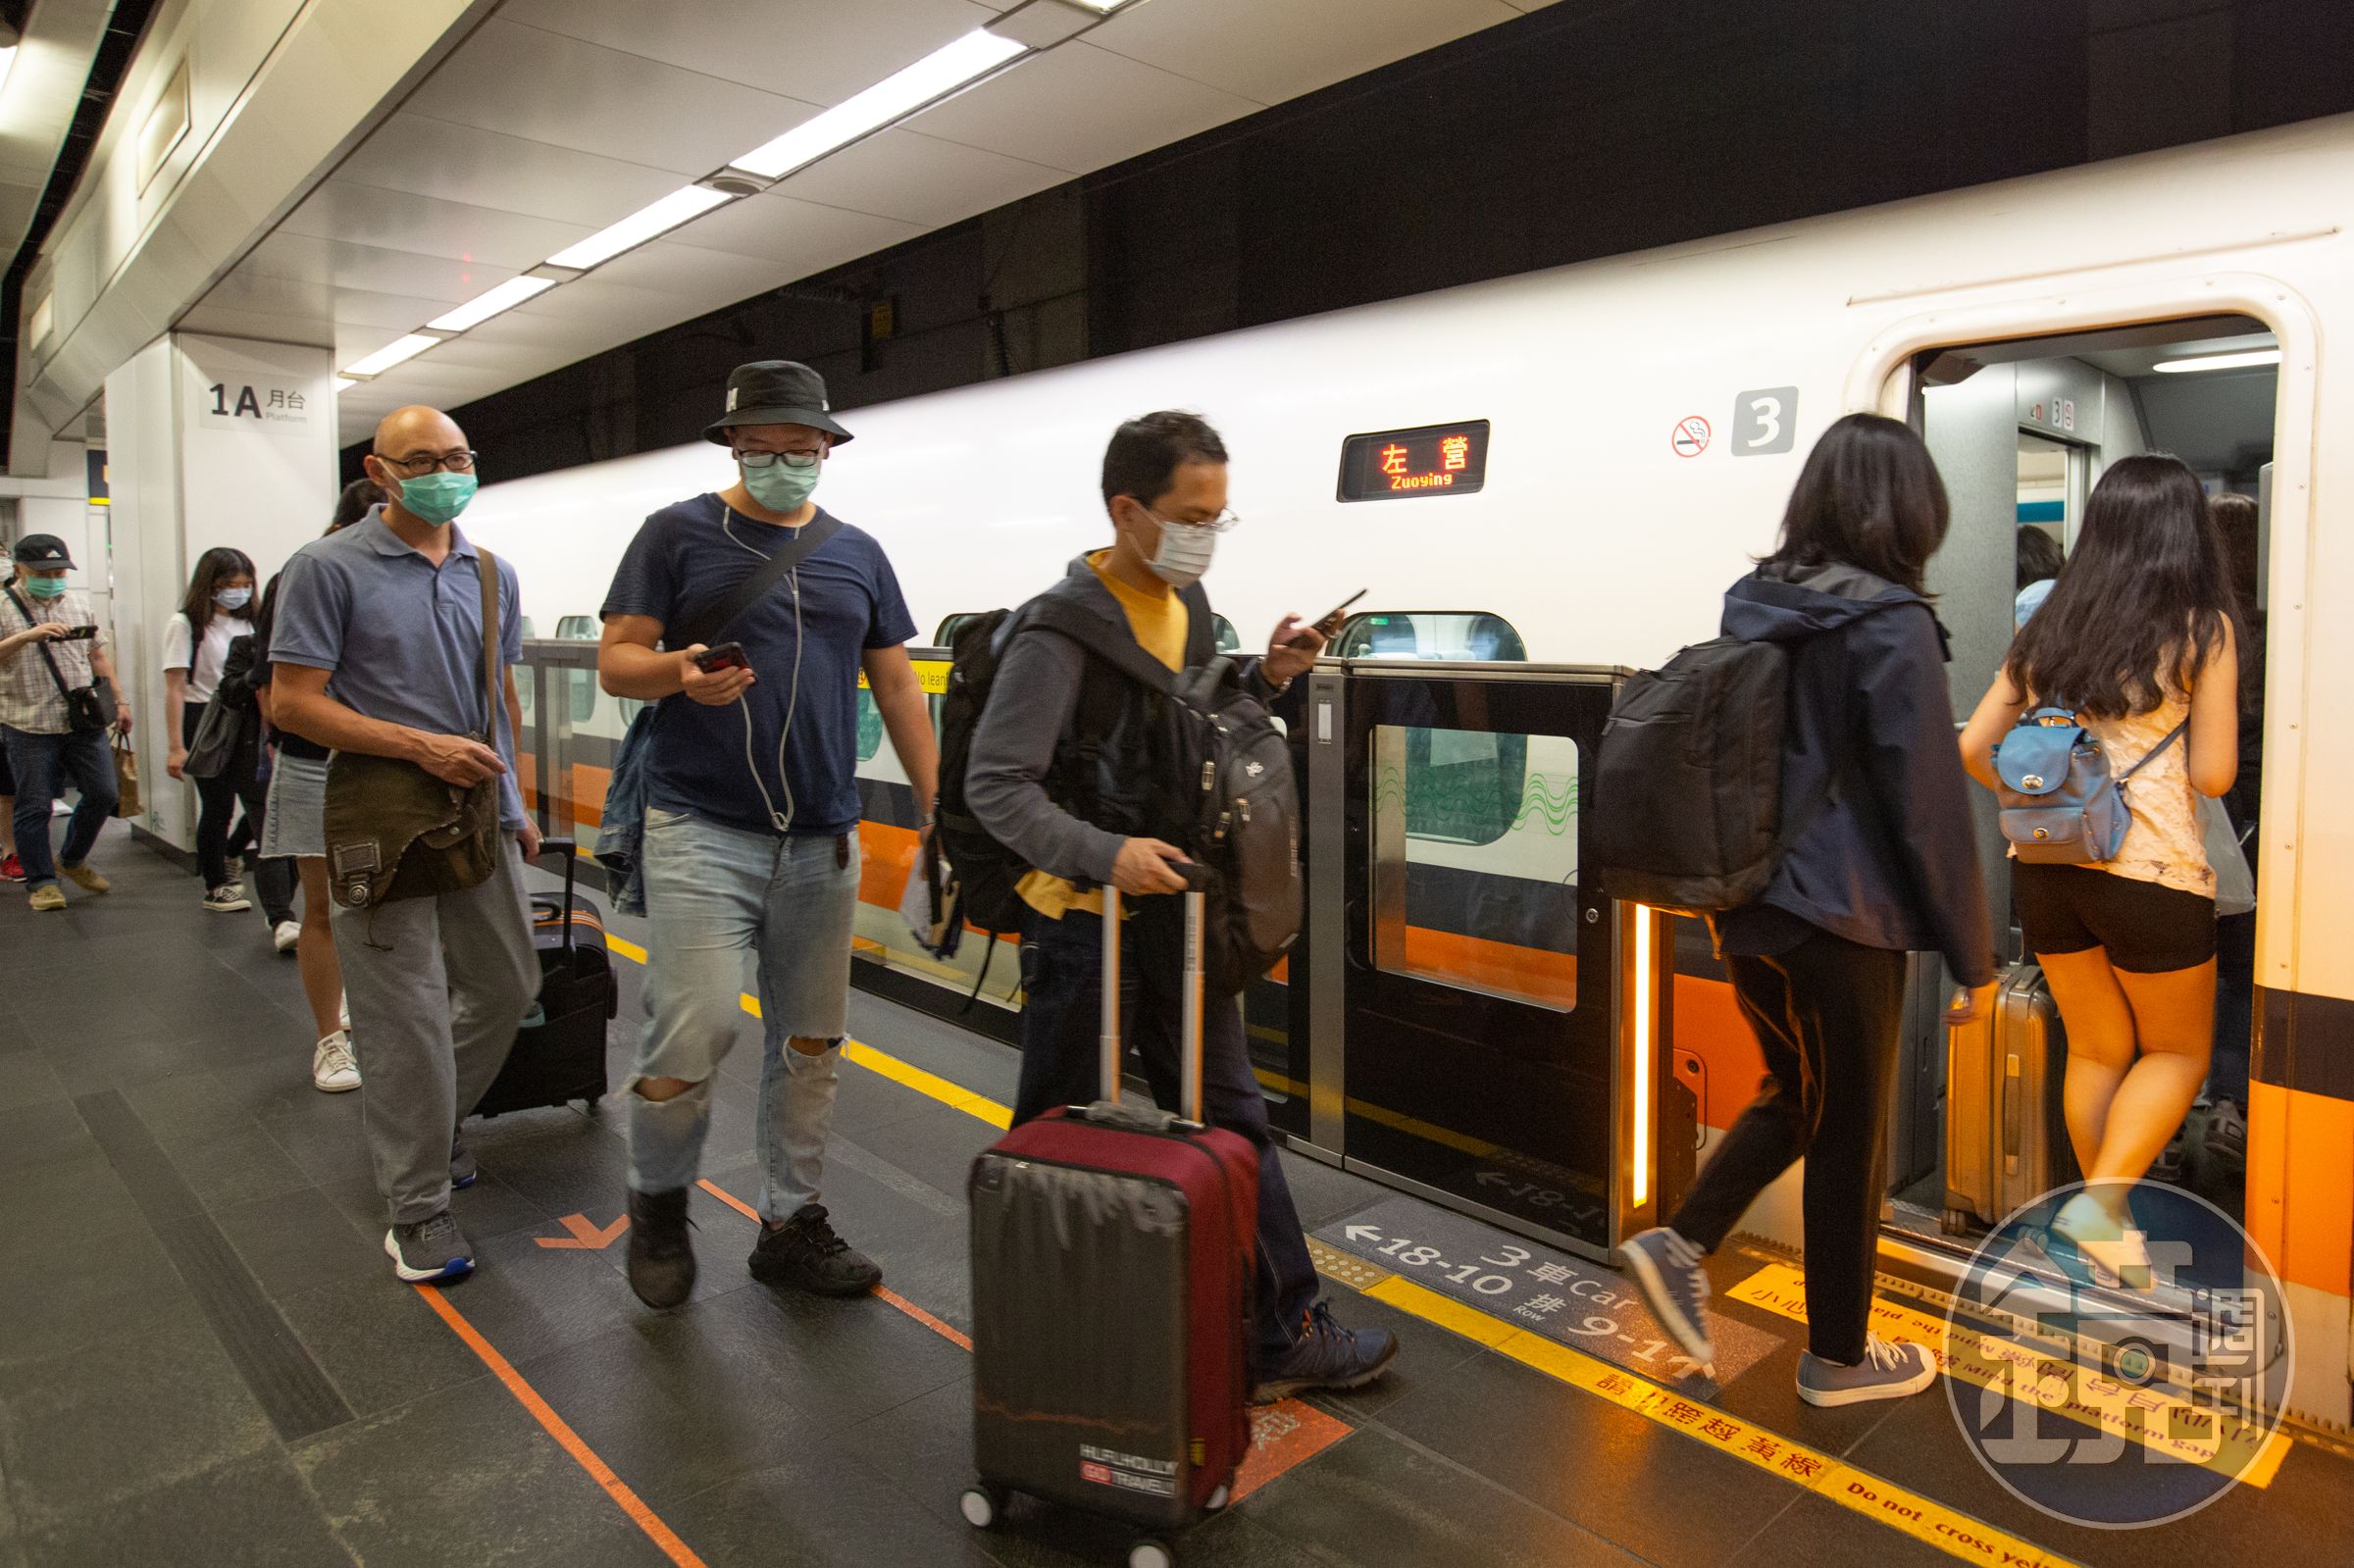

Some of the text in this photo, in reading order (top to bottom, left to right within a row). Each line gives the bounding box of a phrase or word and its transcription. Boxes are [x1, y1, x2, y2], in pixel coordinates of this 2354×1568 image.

[209, 382, 262, 419] 1A
[266, 412, 307, 424] Platform
[267, 389, 306, 410] 月台
[1747, 396, 1781, 448] 3
[1391, 472, 1453, 489] Zuoying
[1376, 1238, 1513, 1294] 18-10
[1523, 1293, 1566, 1313] 排
[1569, 1280, 1639, 1309] Car
[1964, 1363, 2015, 1388] Mind
[2020, 1383, 2055, 1400] the
[2064, 1401, 2165, 1442] platform
[2171, 1438, 2217, 1459] gap
[1847, 1482, 1877, 1501] Do
[1882, 1498, 1923, 1522] not
[1935, 1523, 1995, 1554] cross
